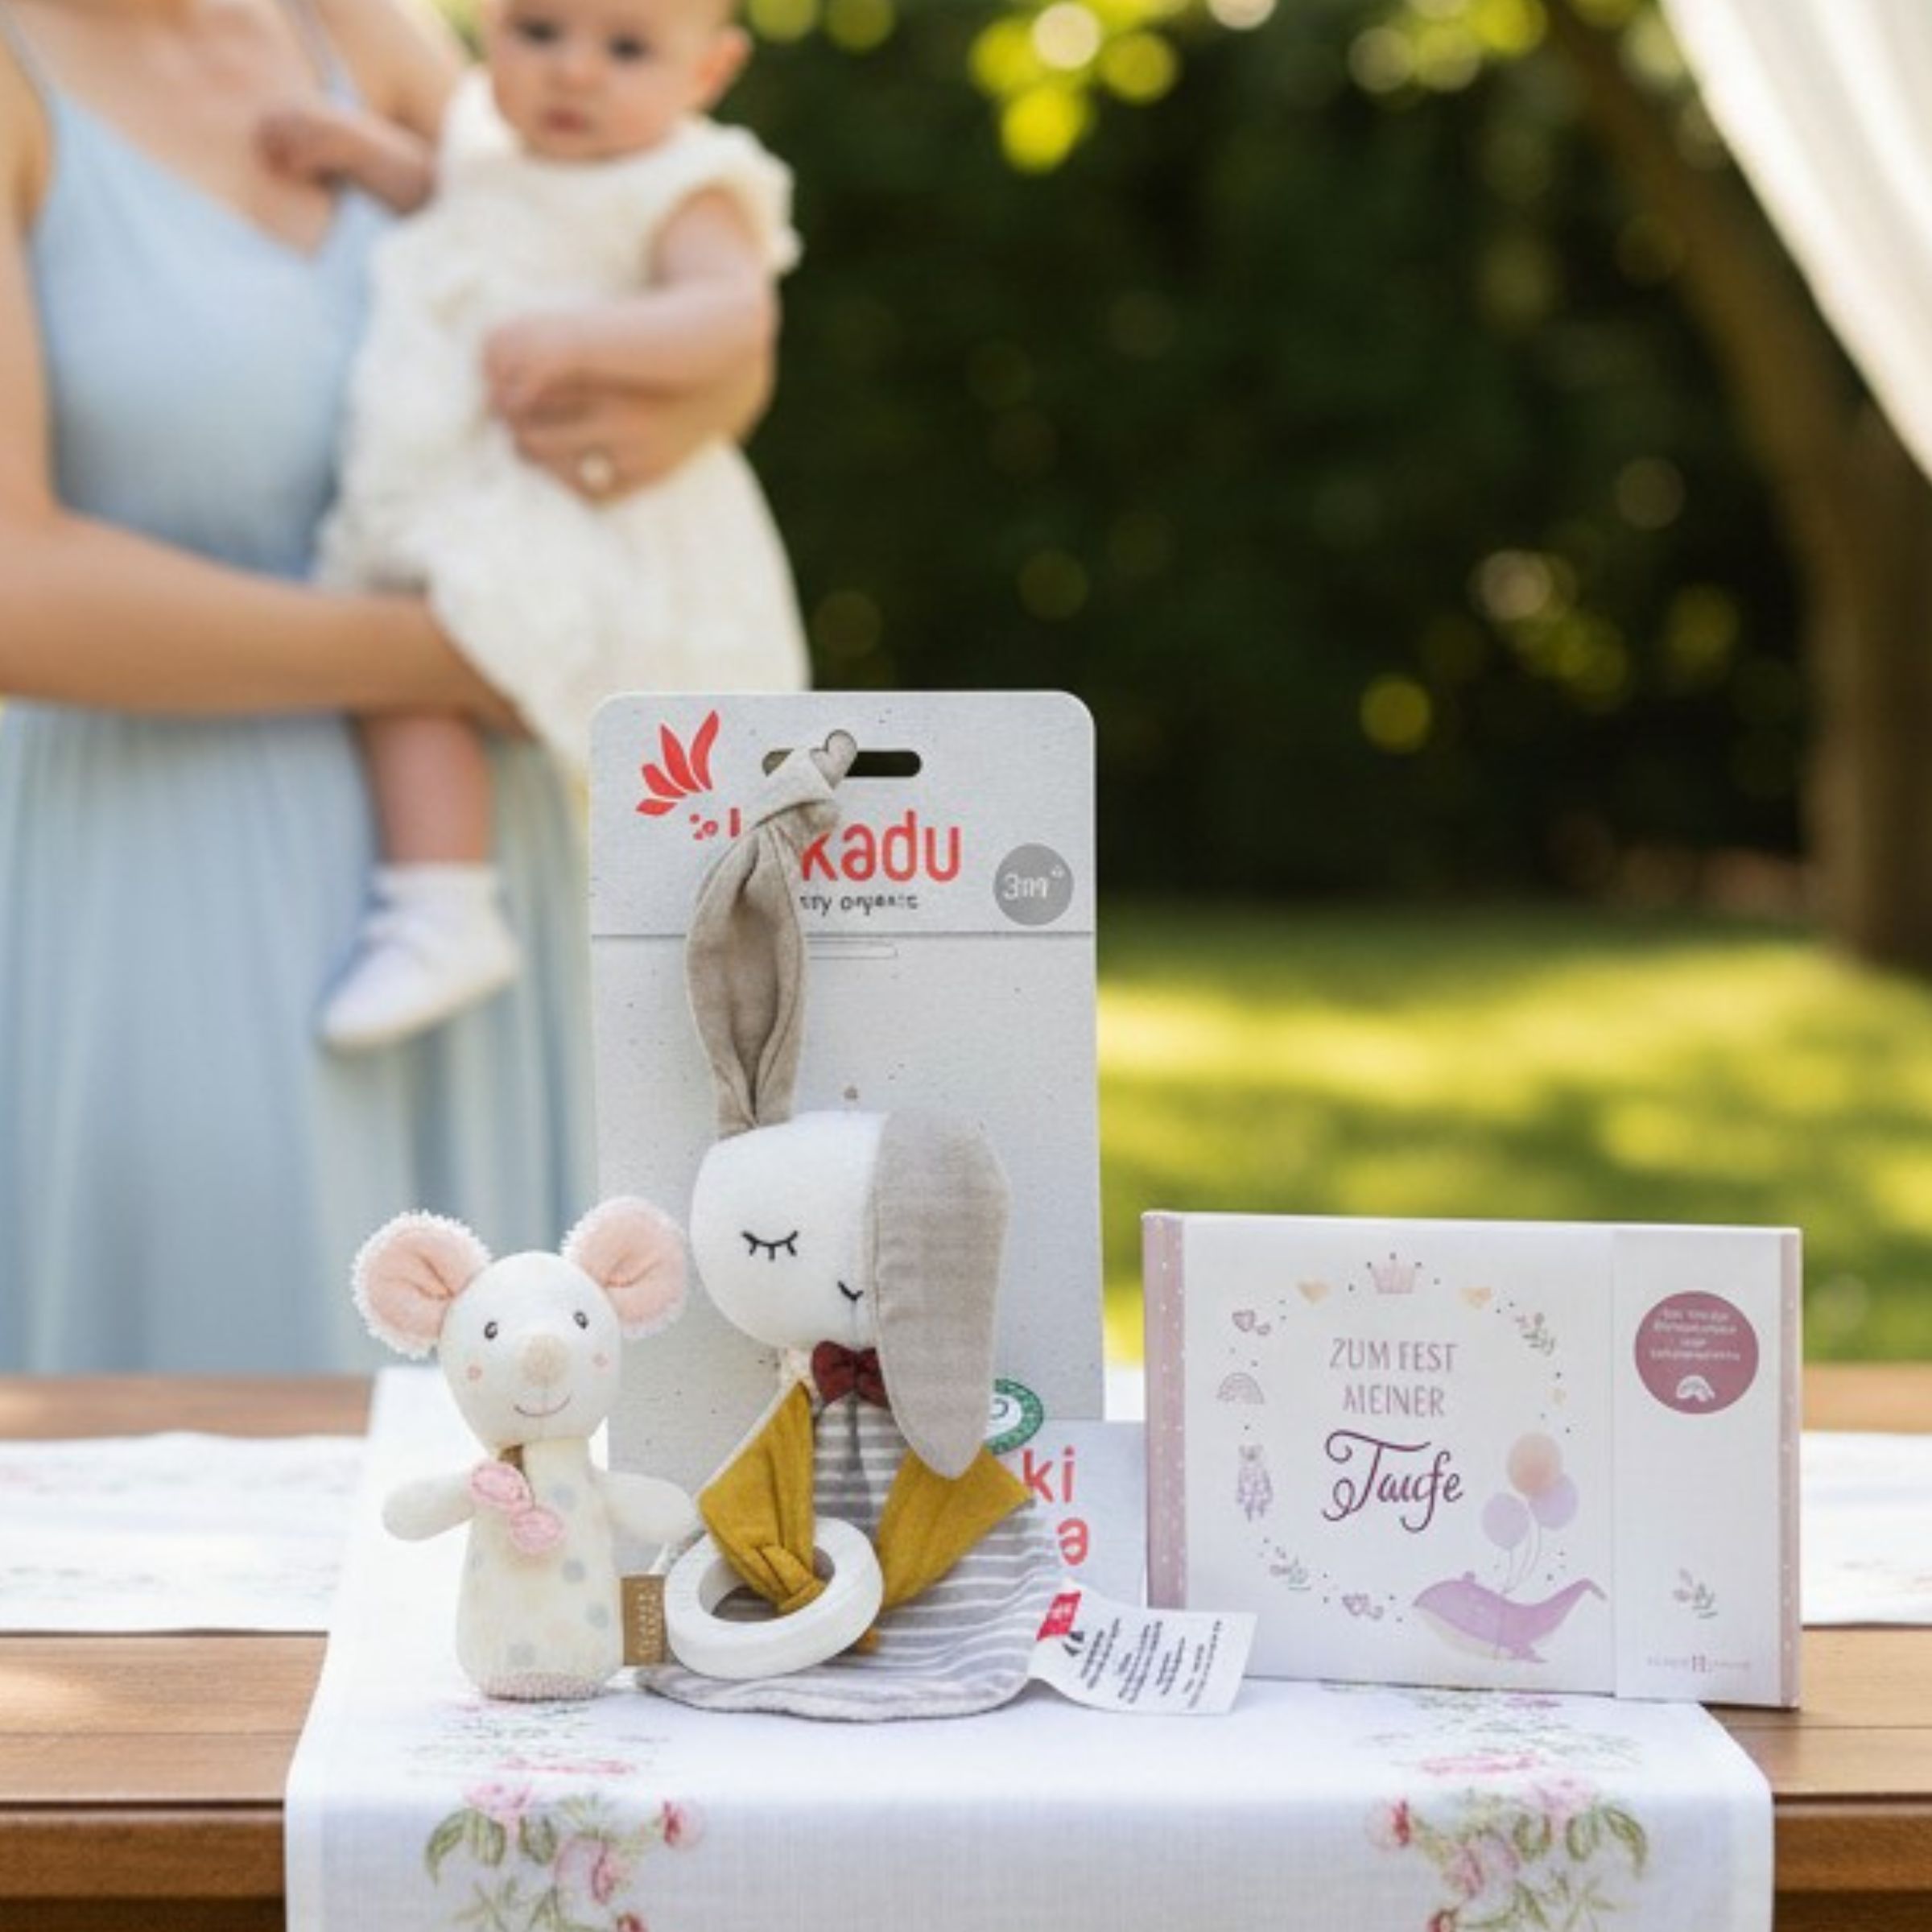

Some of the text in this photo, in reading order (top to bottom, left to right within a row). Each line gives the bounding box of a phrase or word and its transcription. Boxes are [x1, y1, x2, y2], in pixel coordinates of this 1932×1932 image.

[729, 807, 961, 883] kadu
[1329, 1336, 1459, 1373] ZUM FEST
[1342, 1383, 1446, 1418] MEINER
[1322, 1429, 1464, 1534] Taufe
